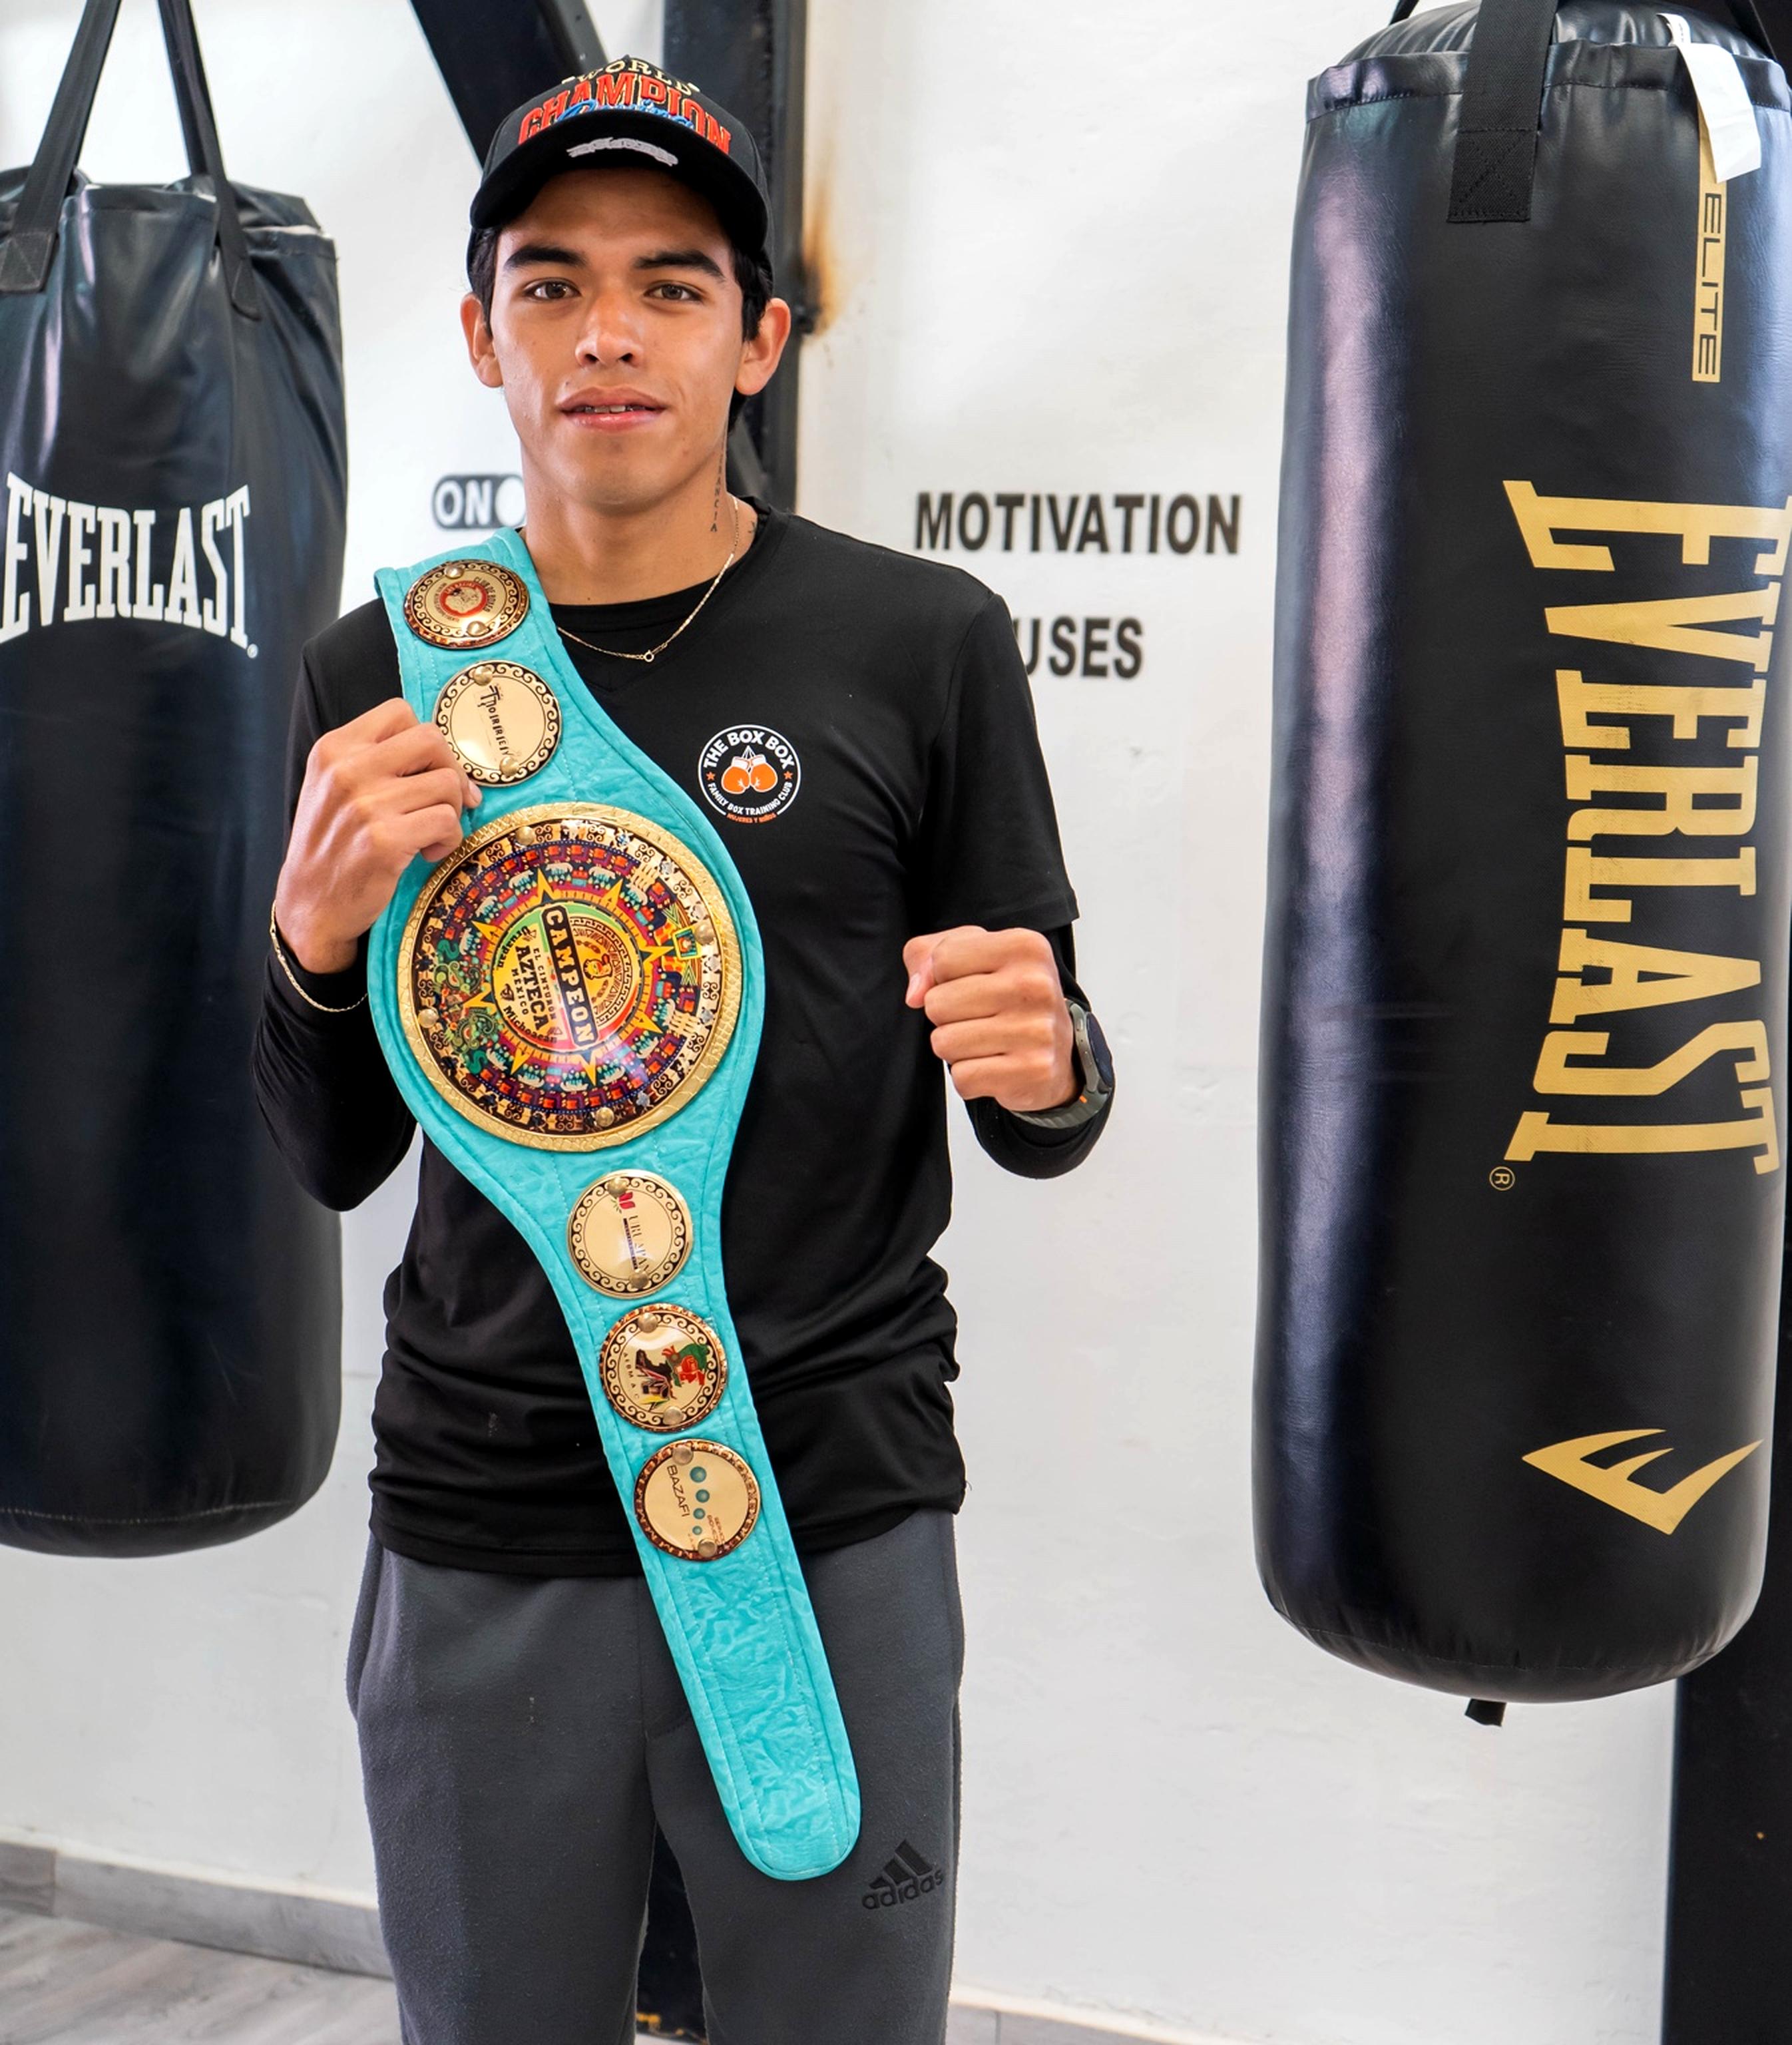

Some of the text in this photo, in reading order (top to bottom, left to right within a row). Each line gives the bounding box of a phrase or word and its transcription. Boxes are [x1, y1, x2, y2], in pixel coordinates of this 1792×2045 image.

[577, 58, 692, 96] WORLD
[519, 72, 732, 154] CHAMPION
[1697, 192, 1721, 375] ELITE
[915, 491, 1241, 555] MOTIVATION
[0, 471, 251, 649] EVERLAST
[703, 730, 795, 770] THE BOX BOX
[708, 781, 793, 816] FAMILY BOX TRAINING CLUB
[1502, 479, 1792, 1176] EVERLAST
[533, 947, 542, 961] EL
[546, 909, 595, 1042] CAMPEON
[515, 945, 549, 1030] AZTECA
[667, 1465, 690, 1517] BAZAFI
[862, 1869, 944, 1910] adidas
